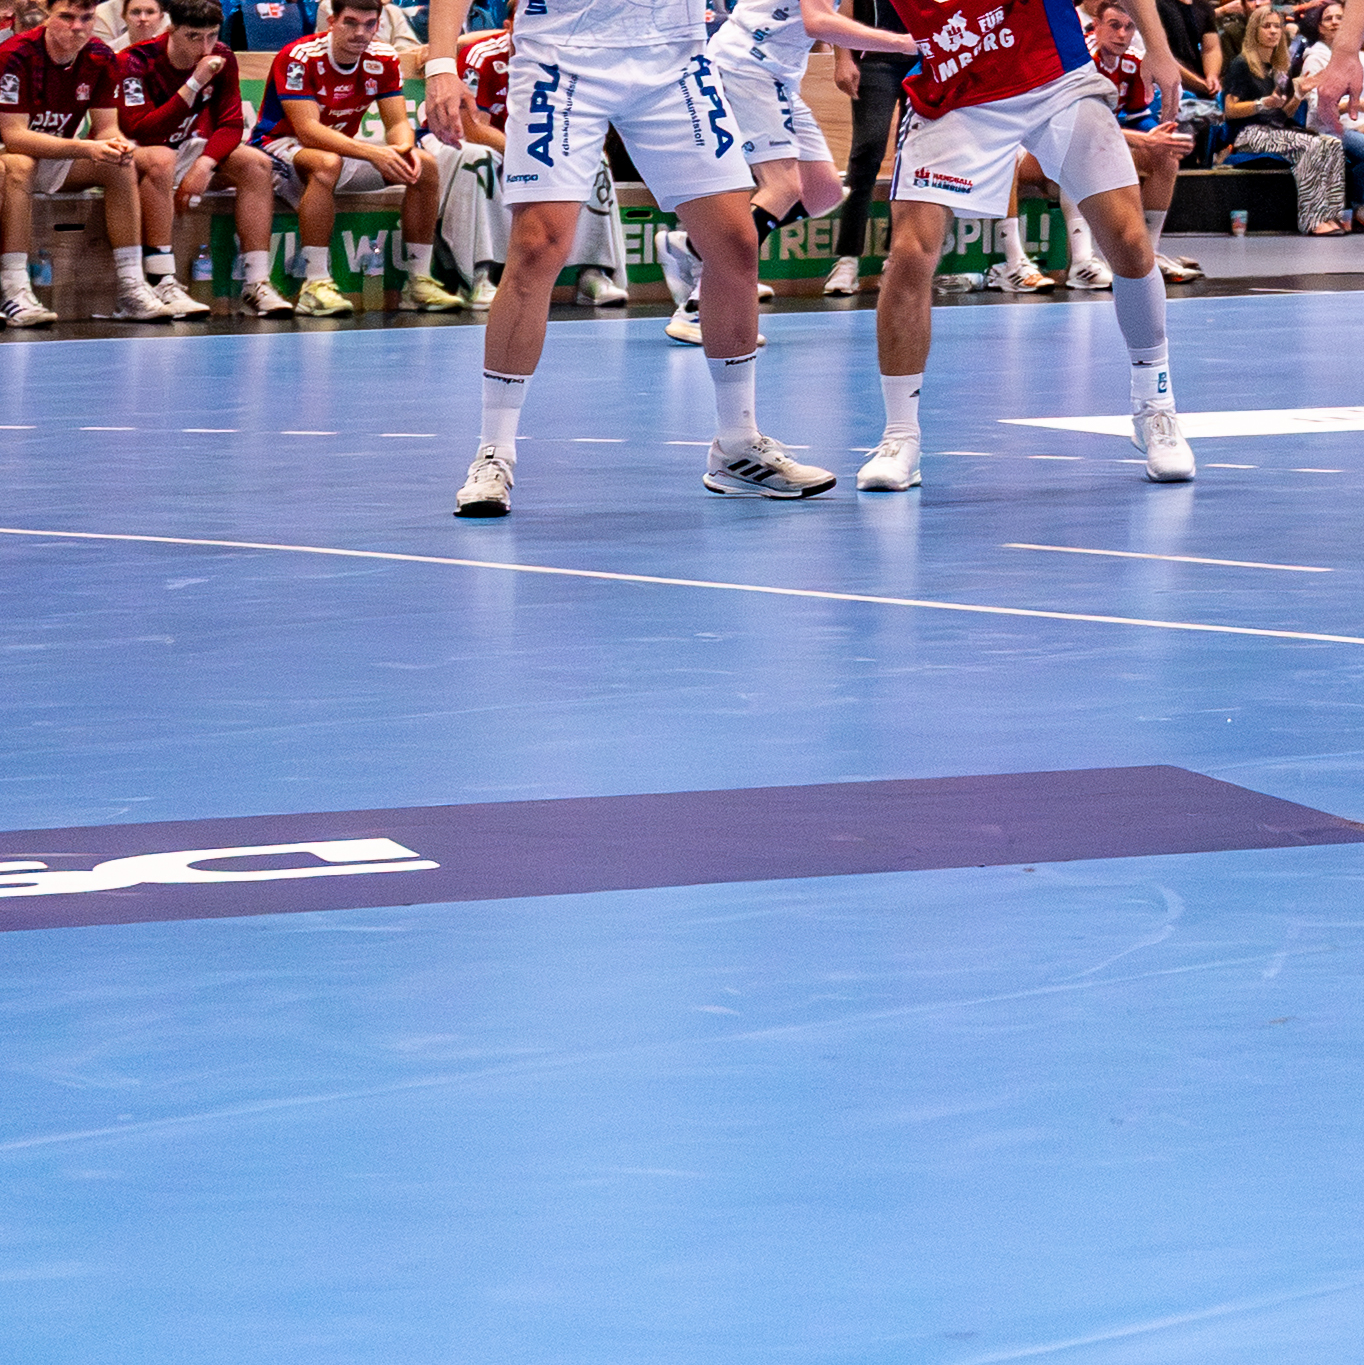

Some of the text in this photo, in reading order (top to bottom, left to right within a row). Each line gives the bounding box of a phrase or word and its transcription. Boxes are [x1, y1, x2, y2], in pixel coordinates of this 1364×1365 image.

[978, 8, 1005, 34] FÜR
[31, 111, 72, 131] play
[506, 173, 539, 183] Kempa
